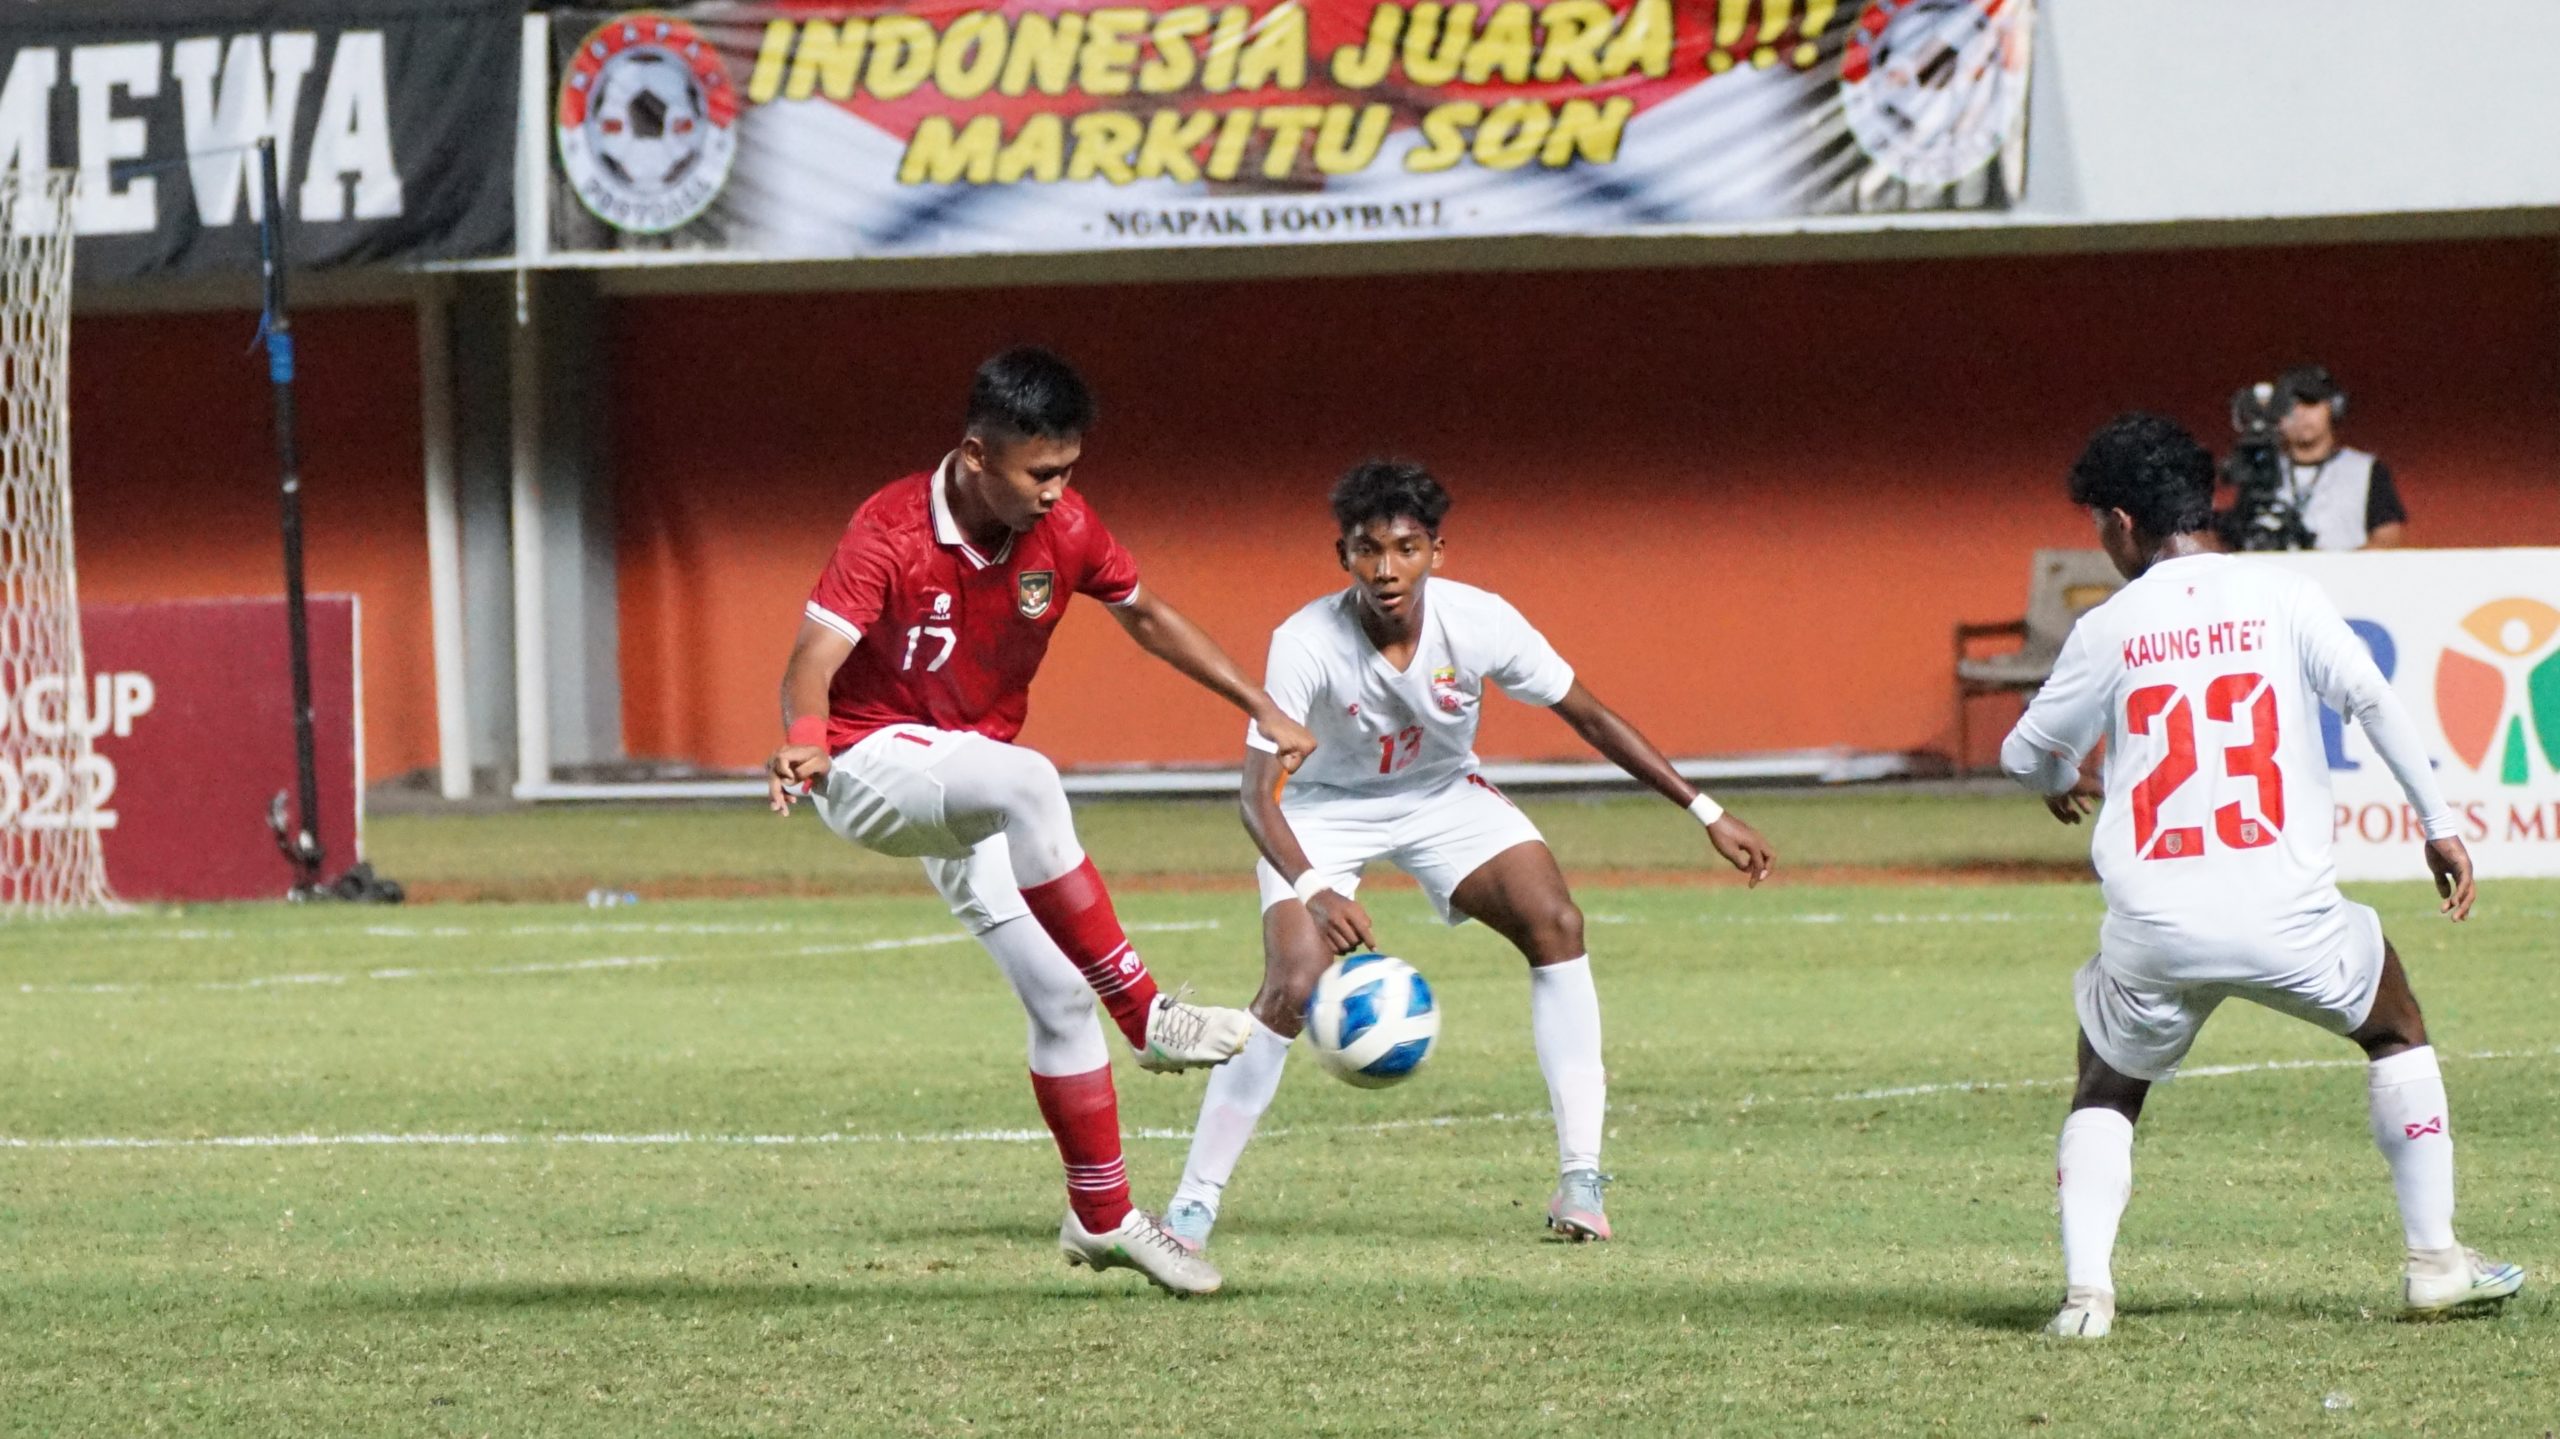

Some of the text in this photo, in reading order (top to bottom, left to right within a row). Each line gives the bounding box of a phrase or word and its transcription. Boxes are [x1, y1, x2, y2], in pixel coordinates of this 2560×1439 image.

[748, 1, 1306, 103] INDONESIA
[1331, 0, 1675, 89] JUARA
[898, 96, 1634, 185] MARKITU SON
[1105, 207, 1248, 235] NGAPAK
[902, 625, 957, 672] 17
[2122, 627, 2201, 670] KAUNG
[22, 671, 155, 738] CUP
[1378, 724, 1424, 775] 13
[2125, 671, 2285, 861] 23
[2332, 801, 2490, 845] PORS
